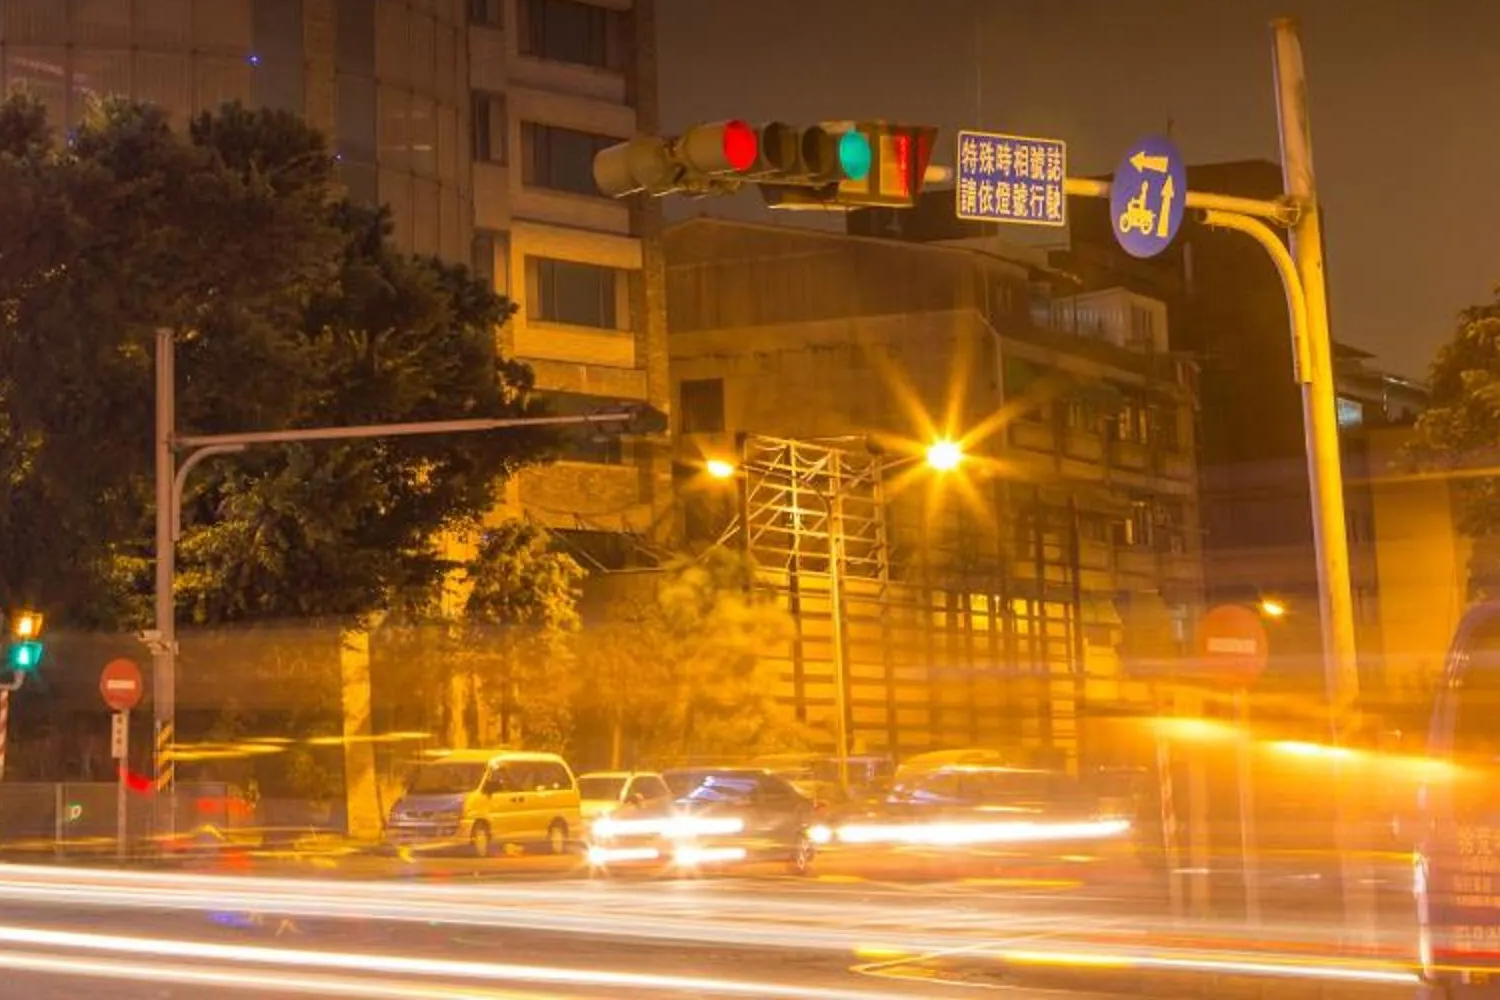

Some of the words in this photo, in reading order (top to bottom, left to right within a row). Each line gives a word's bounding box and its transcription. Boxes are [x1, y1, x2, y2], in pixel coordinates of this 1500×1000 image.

[962, 138, 1062, 181] 特殊時相號誌
[961, 178, 1061, 219] 請依燈號行駛
